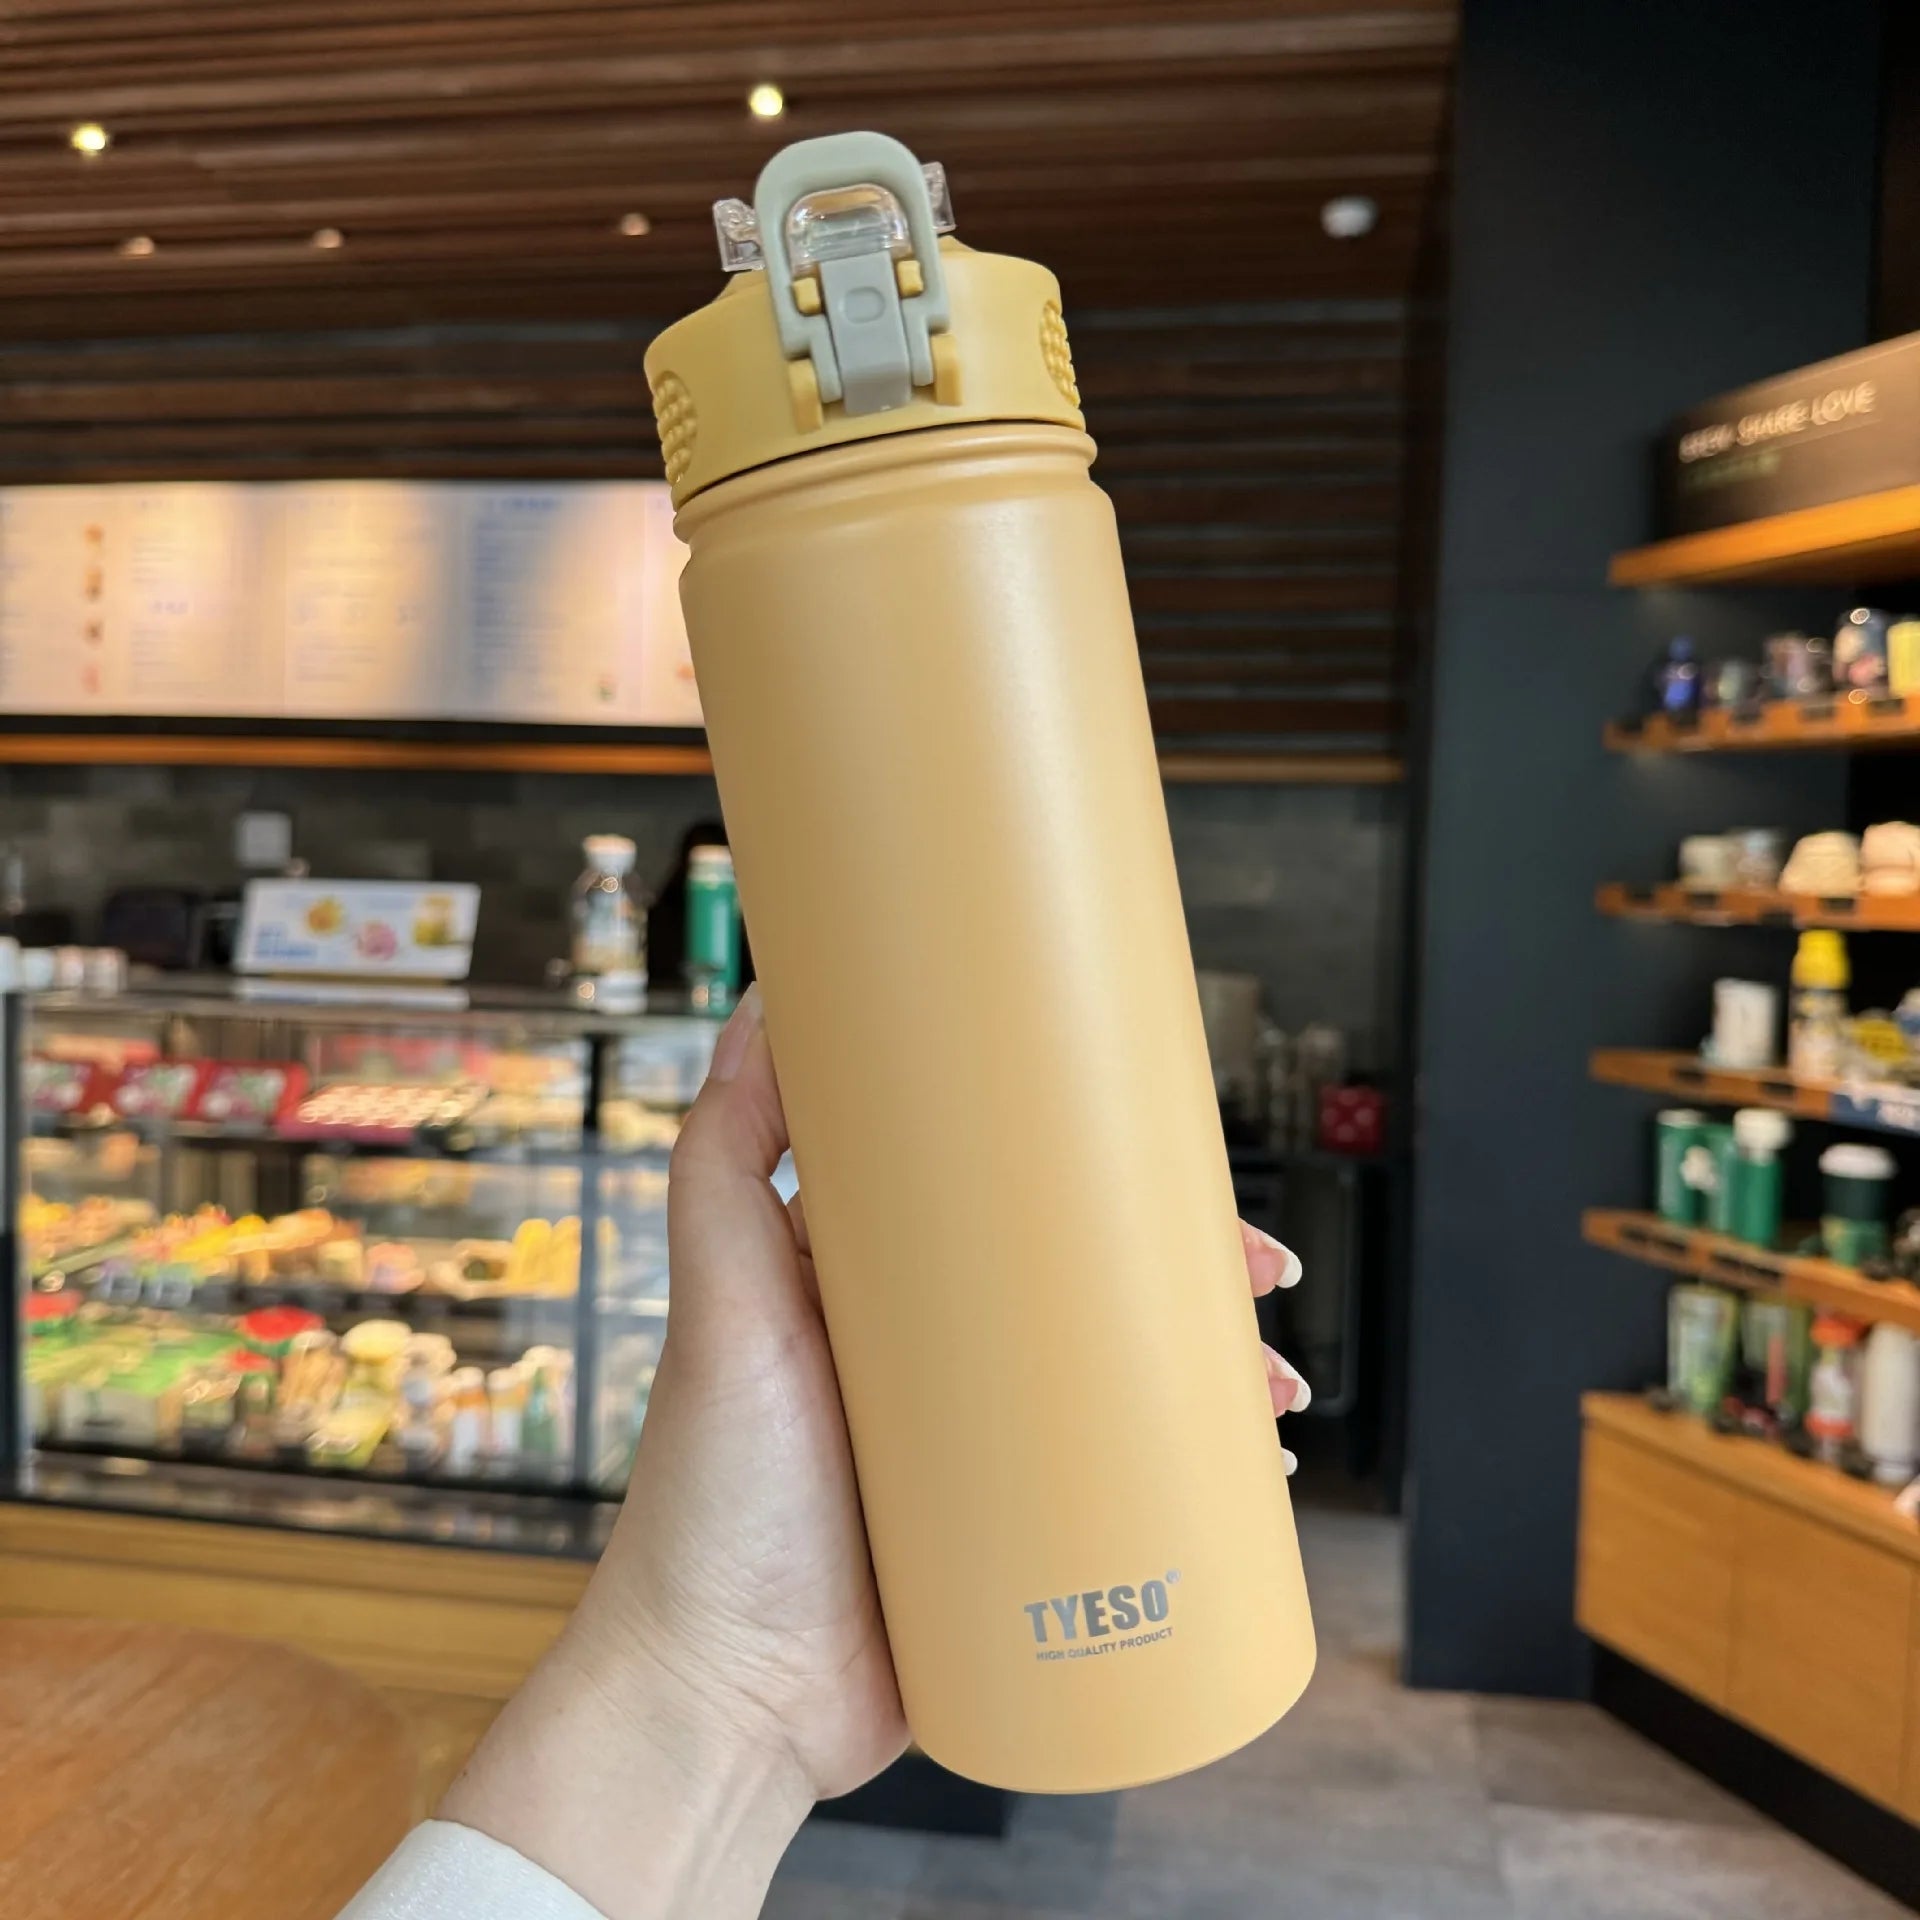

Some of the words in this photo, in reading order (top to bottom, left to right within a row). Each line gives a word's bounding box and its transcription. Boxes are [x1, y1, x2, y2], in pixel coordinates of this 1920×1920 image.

[1811, 380, 1877, 425] LOVE
[1036, 1650, 1065, 1661] HIGH
[1068, 1642, 1117, 1658] QUALITY
[1119, 1627, 1173, 1650] PRODUCT
